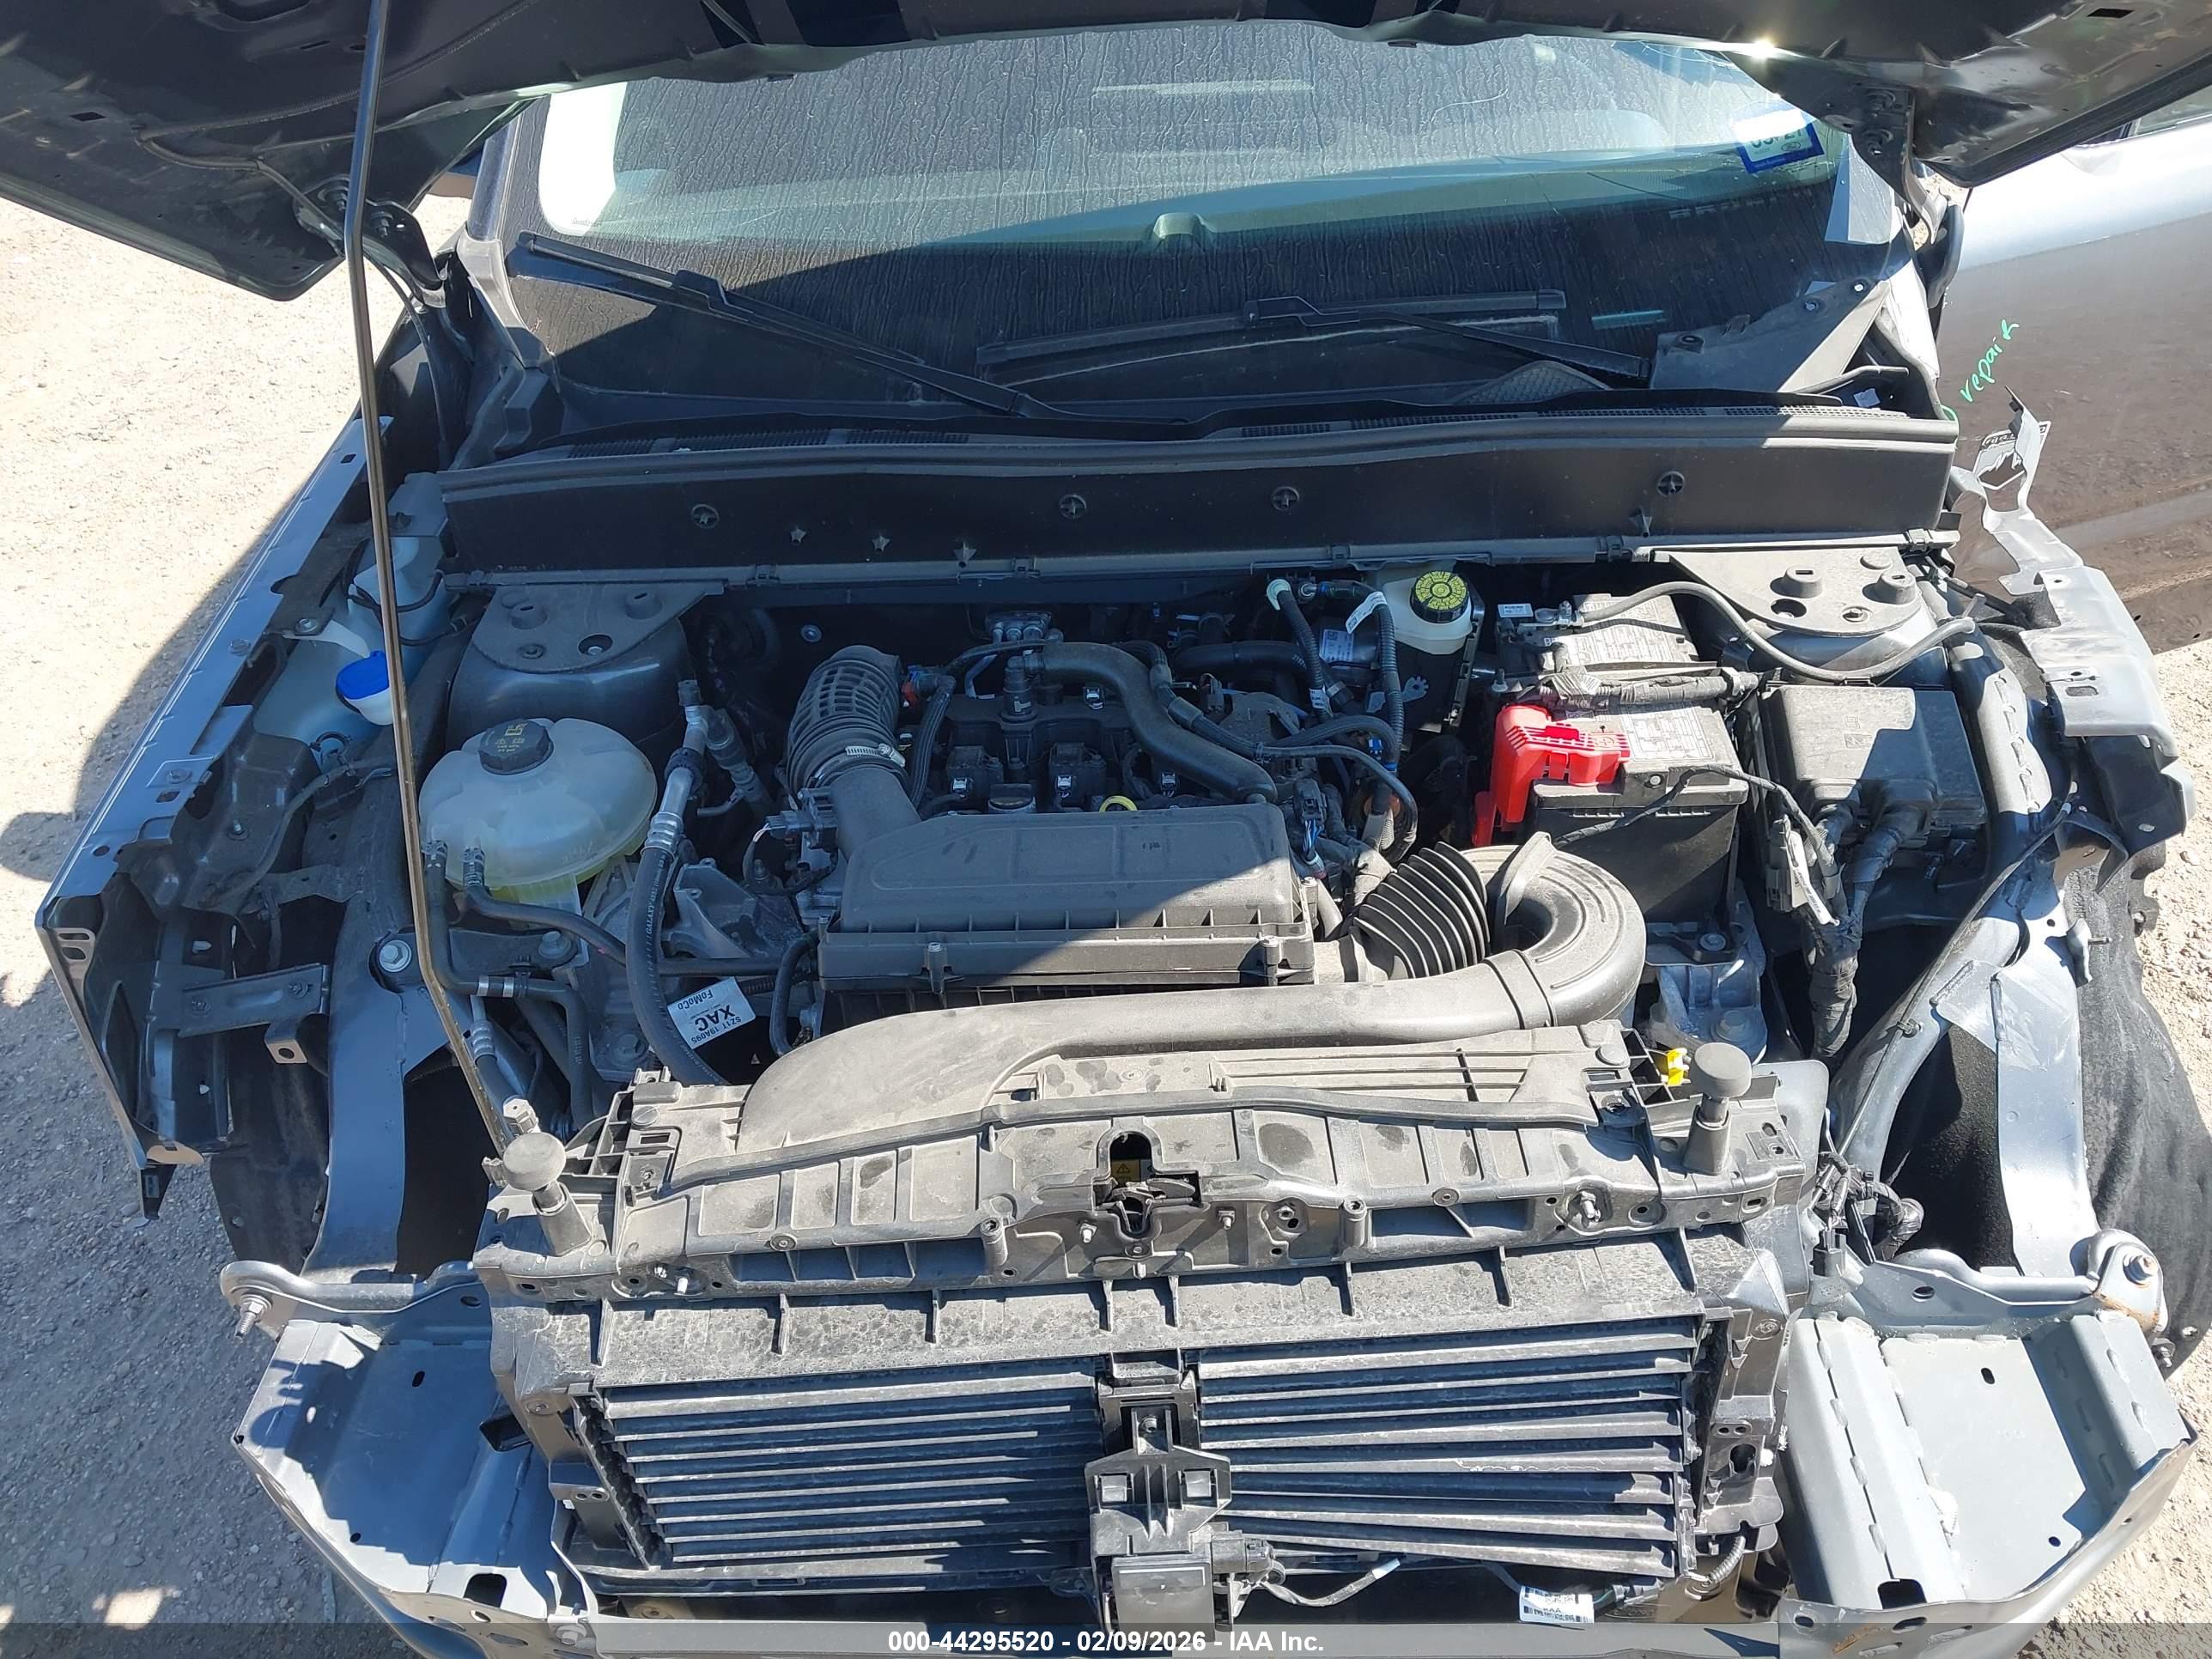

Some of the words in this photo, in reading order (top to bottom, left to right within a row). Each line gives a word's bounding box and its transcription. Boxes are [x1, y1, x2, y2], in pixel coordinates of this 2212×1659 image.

[677, 988, 714, 1010] FoMoCo
[695, 1004, 736, 1032] XAC
[690, 1027, 720, 1044] 19A095
